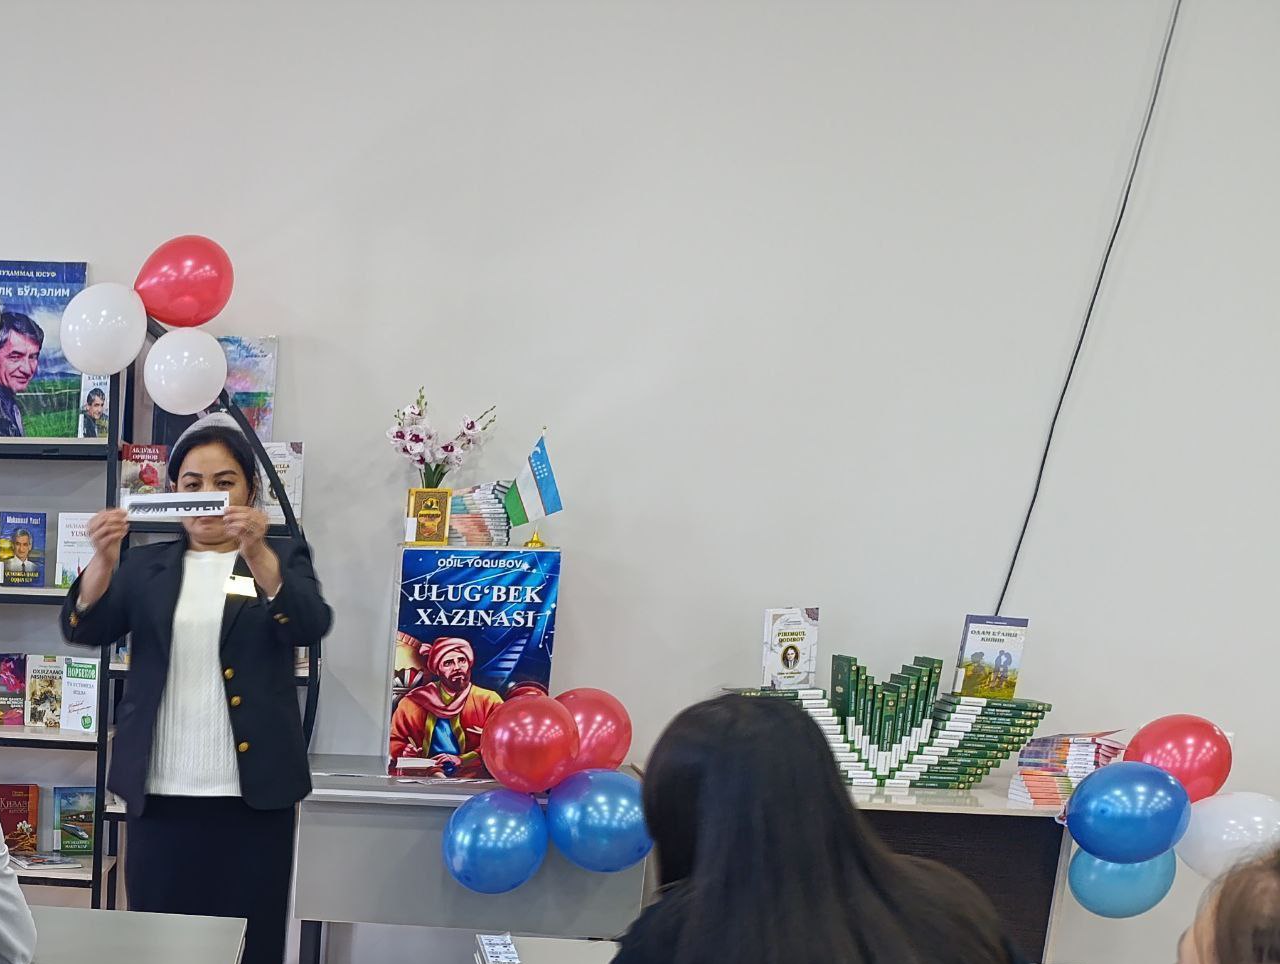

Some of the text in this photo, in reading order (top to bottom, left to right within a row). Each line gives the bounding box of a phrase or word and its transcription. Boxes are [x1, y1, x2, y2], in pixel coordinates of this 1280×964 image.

[437, 558, 523, 569] ODIL YOQUBOV
[415, 608, 537, 628] XAZINASI
[777, 630, 807, 638] PIRIMQUL
[66, 667, 96, 679] НОРБЕКОВ
